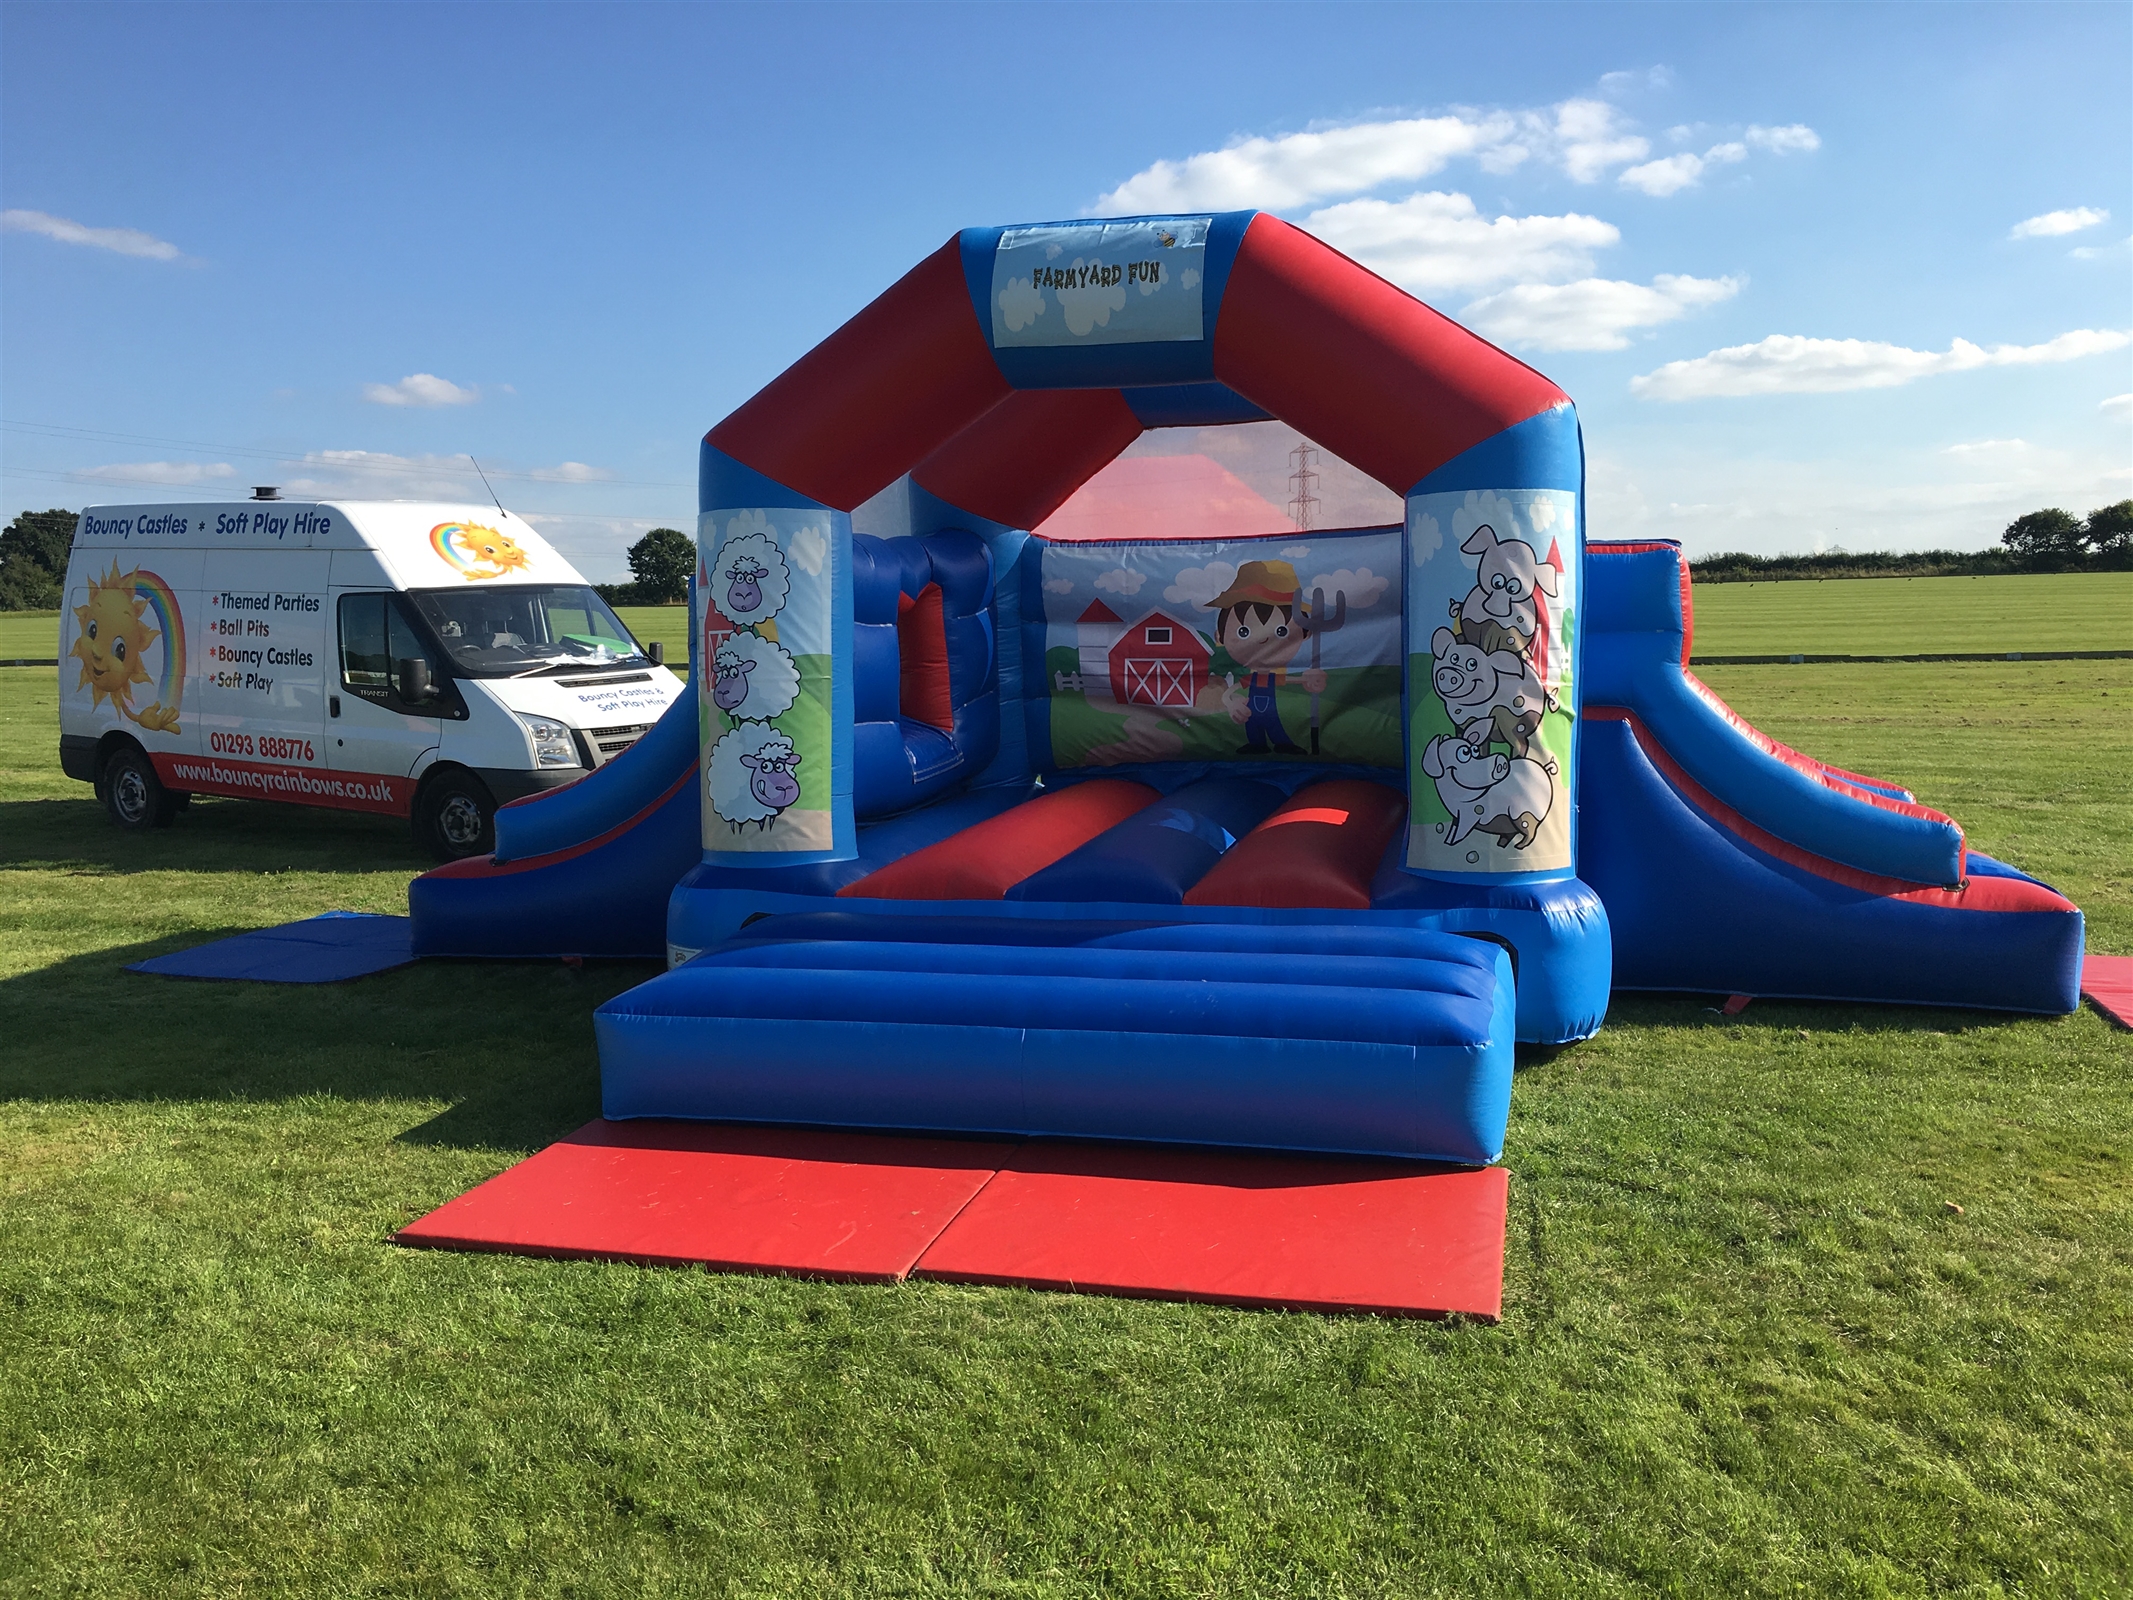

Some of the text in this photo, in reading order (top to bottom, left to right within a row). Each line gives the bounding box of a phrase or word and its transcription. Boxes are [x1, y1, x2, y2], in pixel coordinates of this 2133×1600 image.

[1033, 261, 1160, 290] FARMYARD FUN
[84, 511, 331, 540] Bouncy Castles Soft Play Hire
[221, 593, 320, 612] Themed Parties
[219, 618, 270, 637] Ball Pits
[218, 645, 313, 668] Bouncy Castles
[217, 671, 274, 695] Soft Play
[578, 687, 664, 703] Bouncy Castles &
[597, 698, 668, 712] Soft Play Hire
[210, 731, 315, 762] 01293 888776
[173, 762, 394, 802] www.bouncyrainbows.co.uk
